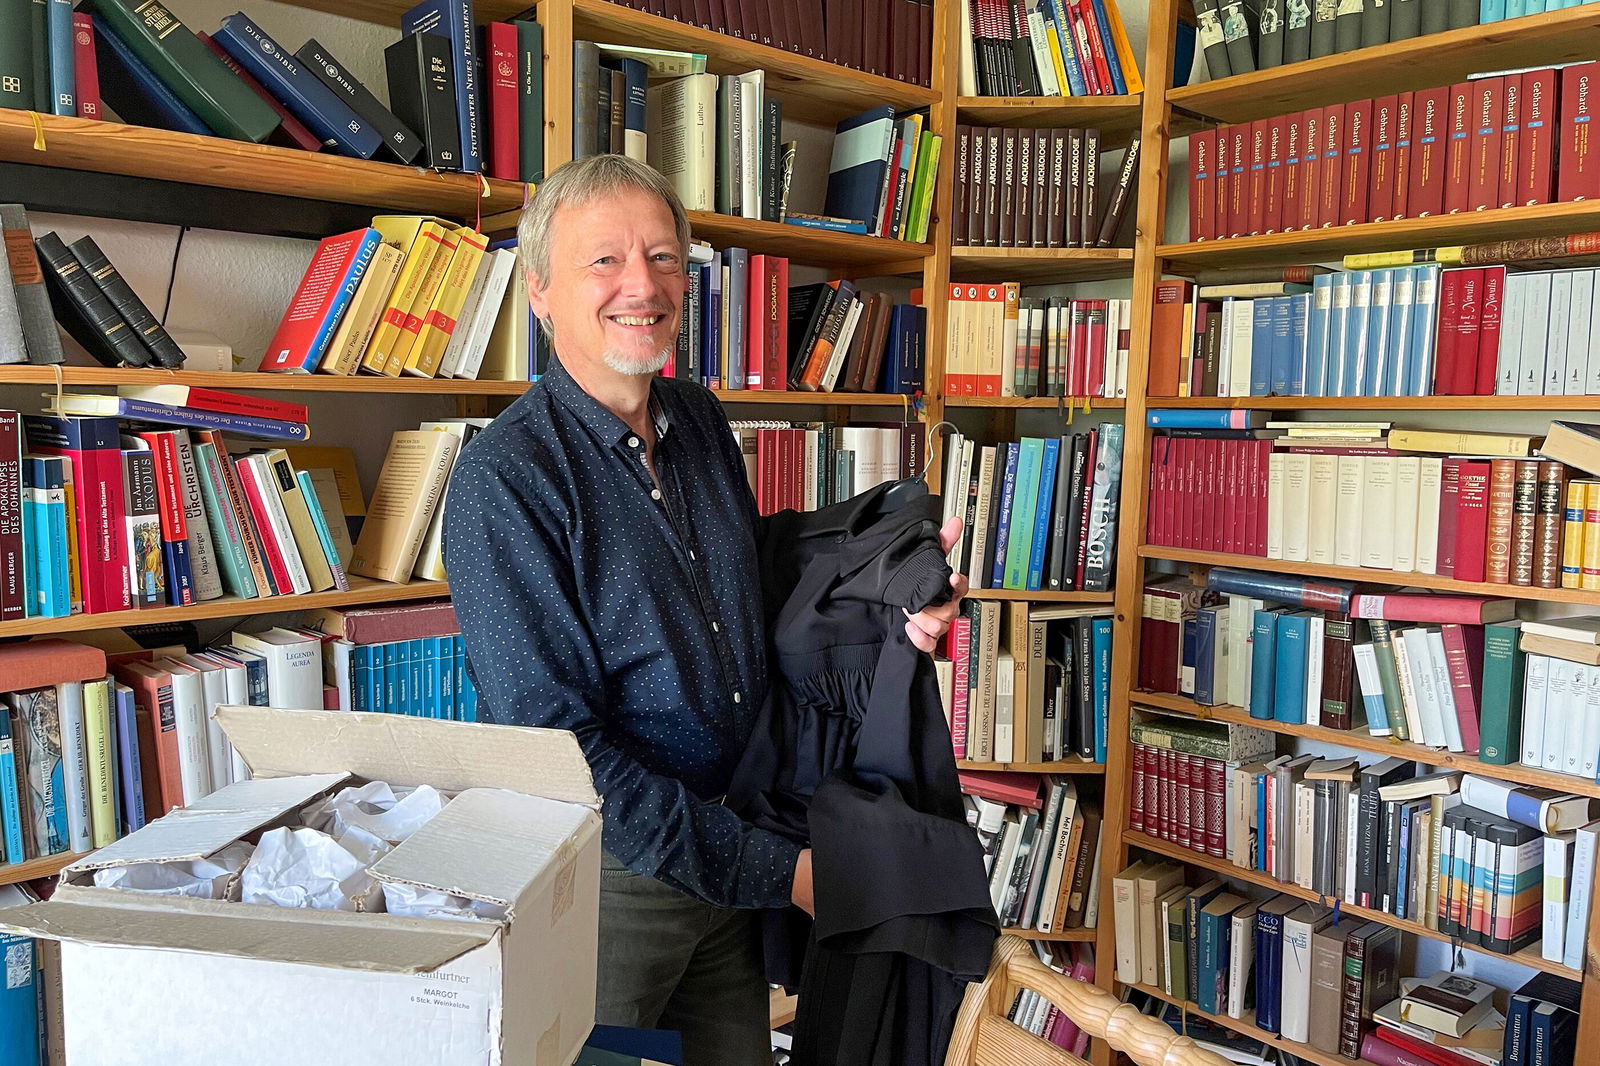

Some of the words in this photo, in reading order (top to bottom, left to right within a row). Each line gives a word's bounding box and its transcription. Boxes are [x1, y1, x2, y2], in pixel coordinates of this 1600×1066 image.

[463, 2, 472, 57] TESTAMENT
[245, 25, 261, 41] DIE
[274, 51, 298, 76] BIBEL
[314, 52, 327, 68] DIE
[336, 74, 356, 96] BIBEL
[465, 59, 474, 90] NEUES
[1482, 90, 1491, 126] Gebhardt
[1507, 86, 1516, 123] Gebhardt
[1532, 81, 1541, 118] Gebhardt
[1578, 76, 1588, 114] Gebhardt
[468, 93, 478, 157] STUTTGARTER
[1352, 112, 1360, 146] Gebhardt
[1380, 108, 1388, 142] Gebhardt
[1399, 104, 1408, 139] Gebhardt
[1425, 99, 1434, 134] Gebhardt
[1456, 95, 1464, 131] Gebhardt
[1271, 128, 1279, 160] Gebhardt
[1308, 120, 1316, 153] Gebhardt
[1328, 116, 1336, 149] Gebhardt
[1462, 280, 1475, 312] Novalis
[1485, 279, 1498, 311] Novalis
[395, 313, 401, 323] 1
[408, 320, 417, 329] 2
[440, 317, 447, 327] 3
[829, 298, 850, 342] JERUSALEM
[132, 459, 142, 494] Assmann
[141, 458, 155, 510] EXODUS
[180, 443, 203, 517] URCHRISTEN
[423, 486, 437, 516] MARTIN
[438, 446, 451, 471] TOURS
[984, 453, 994, 485] KAPELLEN
[0, 460, 8, 521] APOKALYPSE
[8, 460, 19, 517] JOHANNES
[134, 497, 143, 512] Jan
[184, 504, 193, 519] DIE
[980, 492, 990, 520] KLOSTER
[1, 522, 10, 536] DIE
[11, 520, 19, 534] DES
[196, 532, 206, 555] Berger
[976, 526, 986, 555] KIRCHEN
[1087, 497, 1111, 570] BOSCH
[198, 556, 209, 576] Klaus
[122, 565, 130, 607] Kohlhammer
[285, 651, 315, 661] LEGENDA
[955, 619, 971, 694] ITALIENISCHE
[1034, 626, 1043, 659] DÜRER
[291, 659, 311, 668] AUREA
[984, 653, 993, 695] ITALIENISCHE
[953, 695, 968, 748] MALEREI
[1046, 698, 1054, 718] Dürer
[99, 735, 107, 794] BENEDIKTUSREGEL
[1056, 828, 1067, 860] Bochner
[1433, 818, 1441, 862] ALIGHIERI
[1431, 862, 1439, 892] DANTE
[1258, 913, 1279, 925] ECO
[416, 996, 432, 1004] Stck.
[433, 998, 470, 1009] Weinkelche
[424, 988, 458, 999] MARGOT
[1510, 1014, 1521, 1062] Bonaventura
